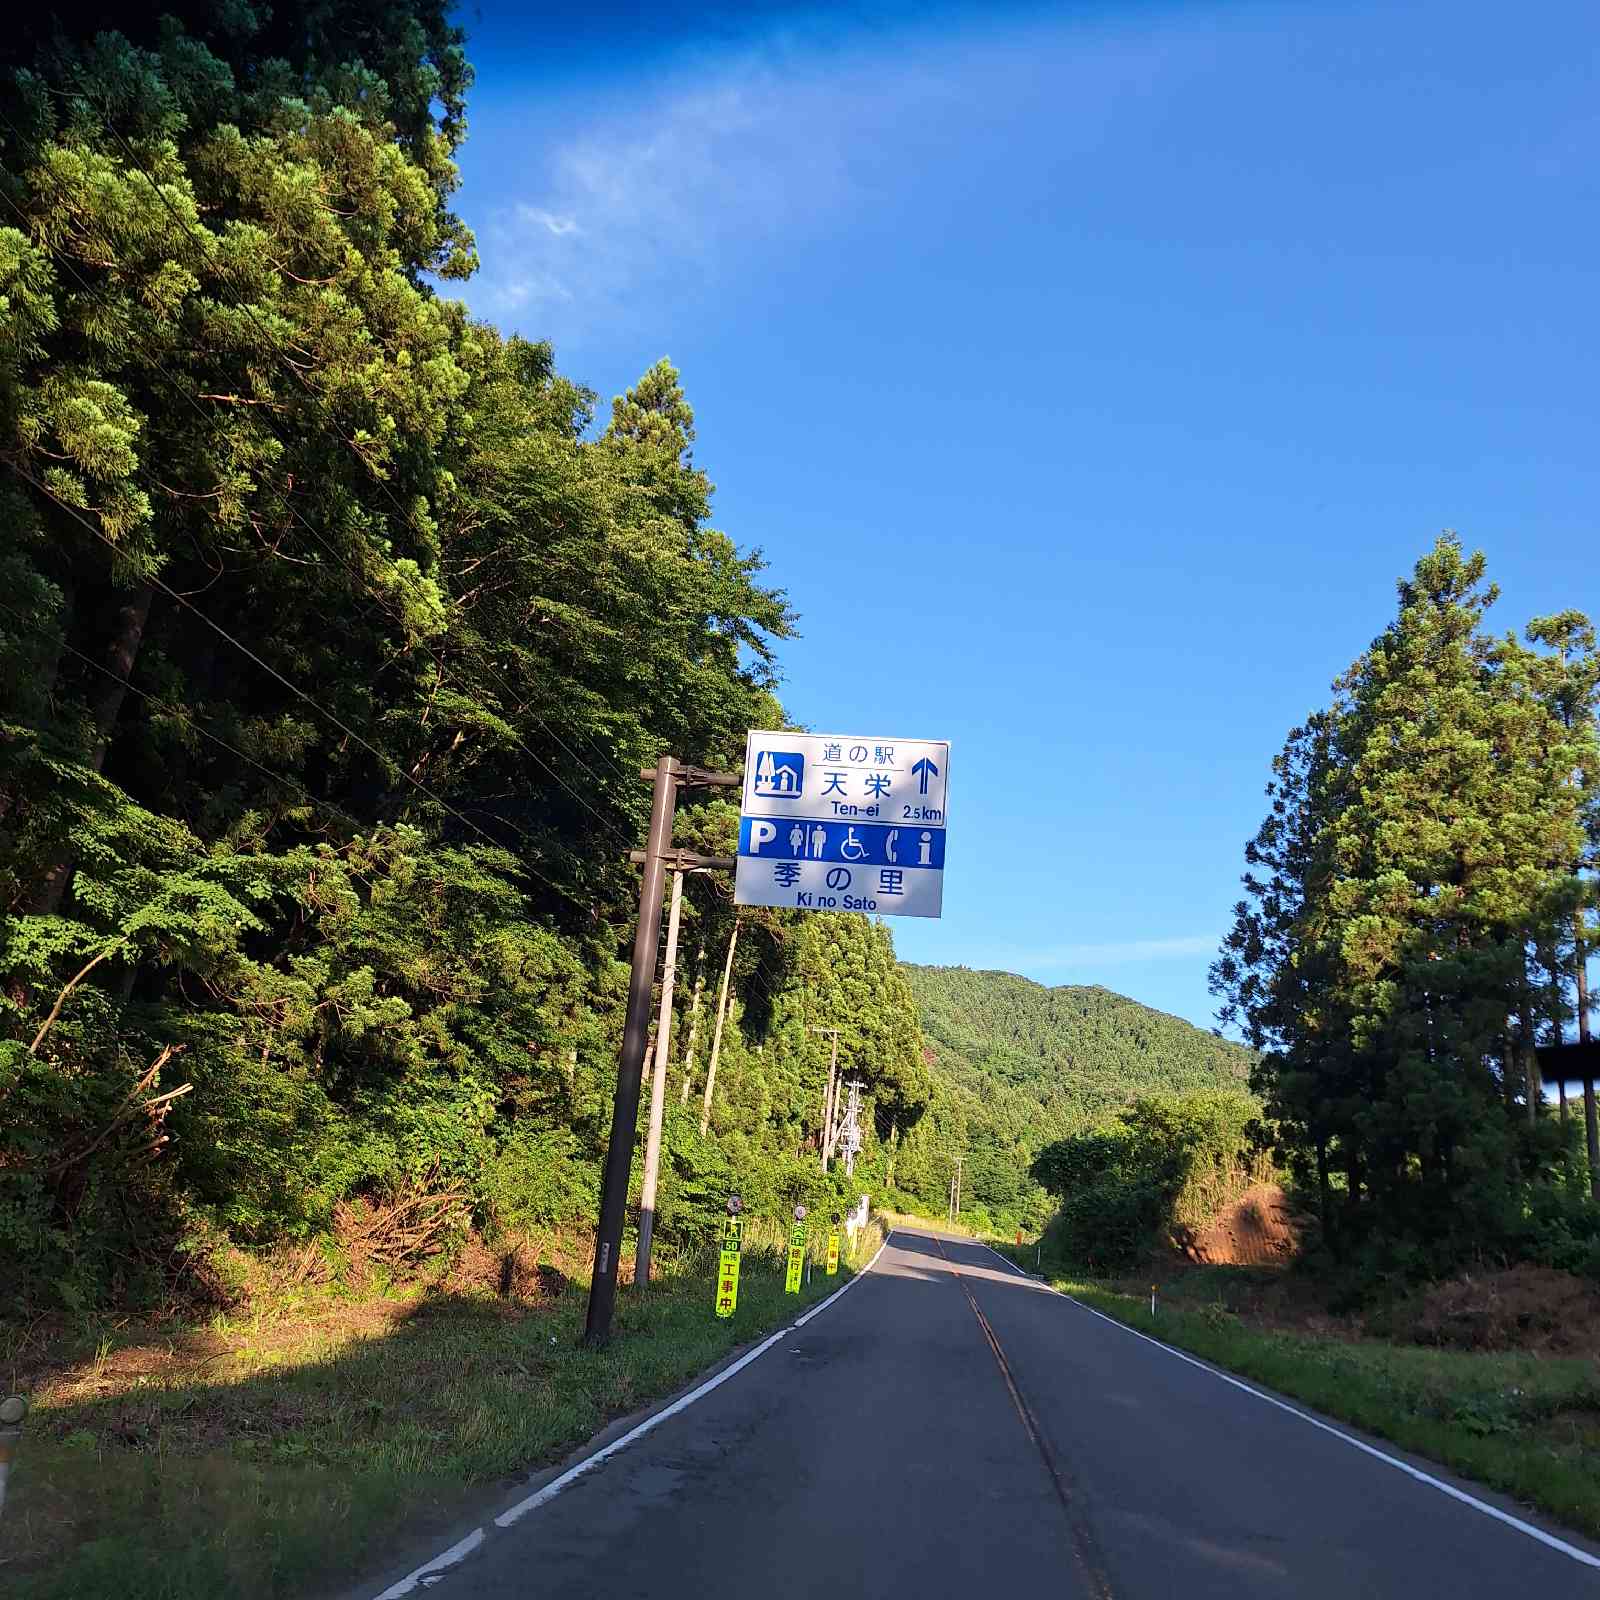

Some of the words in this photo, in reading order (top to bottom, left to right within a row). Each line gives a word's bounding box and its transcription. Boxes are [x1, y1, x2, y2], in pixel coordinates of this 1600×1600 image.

[823, 743, 895, 765] 道の駅
[821, 772, 892, 799] 天栄
[831, 801, 880, 817] Ten-ei
[750, 820, 776, 854] P
[774, 862, 904, 896] 季の里
[797, 892, 812, 906] Ki
[818, 896, 836, 908] no
[843, 895, 877, 911] Sato
[725, 1241, 738, 1251] 50
[720, 1263, 736, 1310] 工事中
